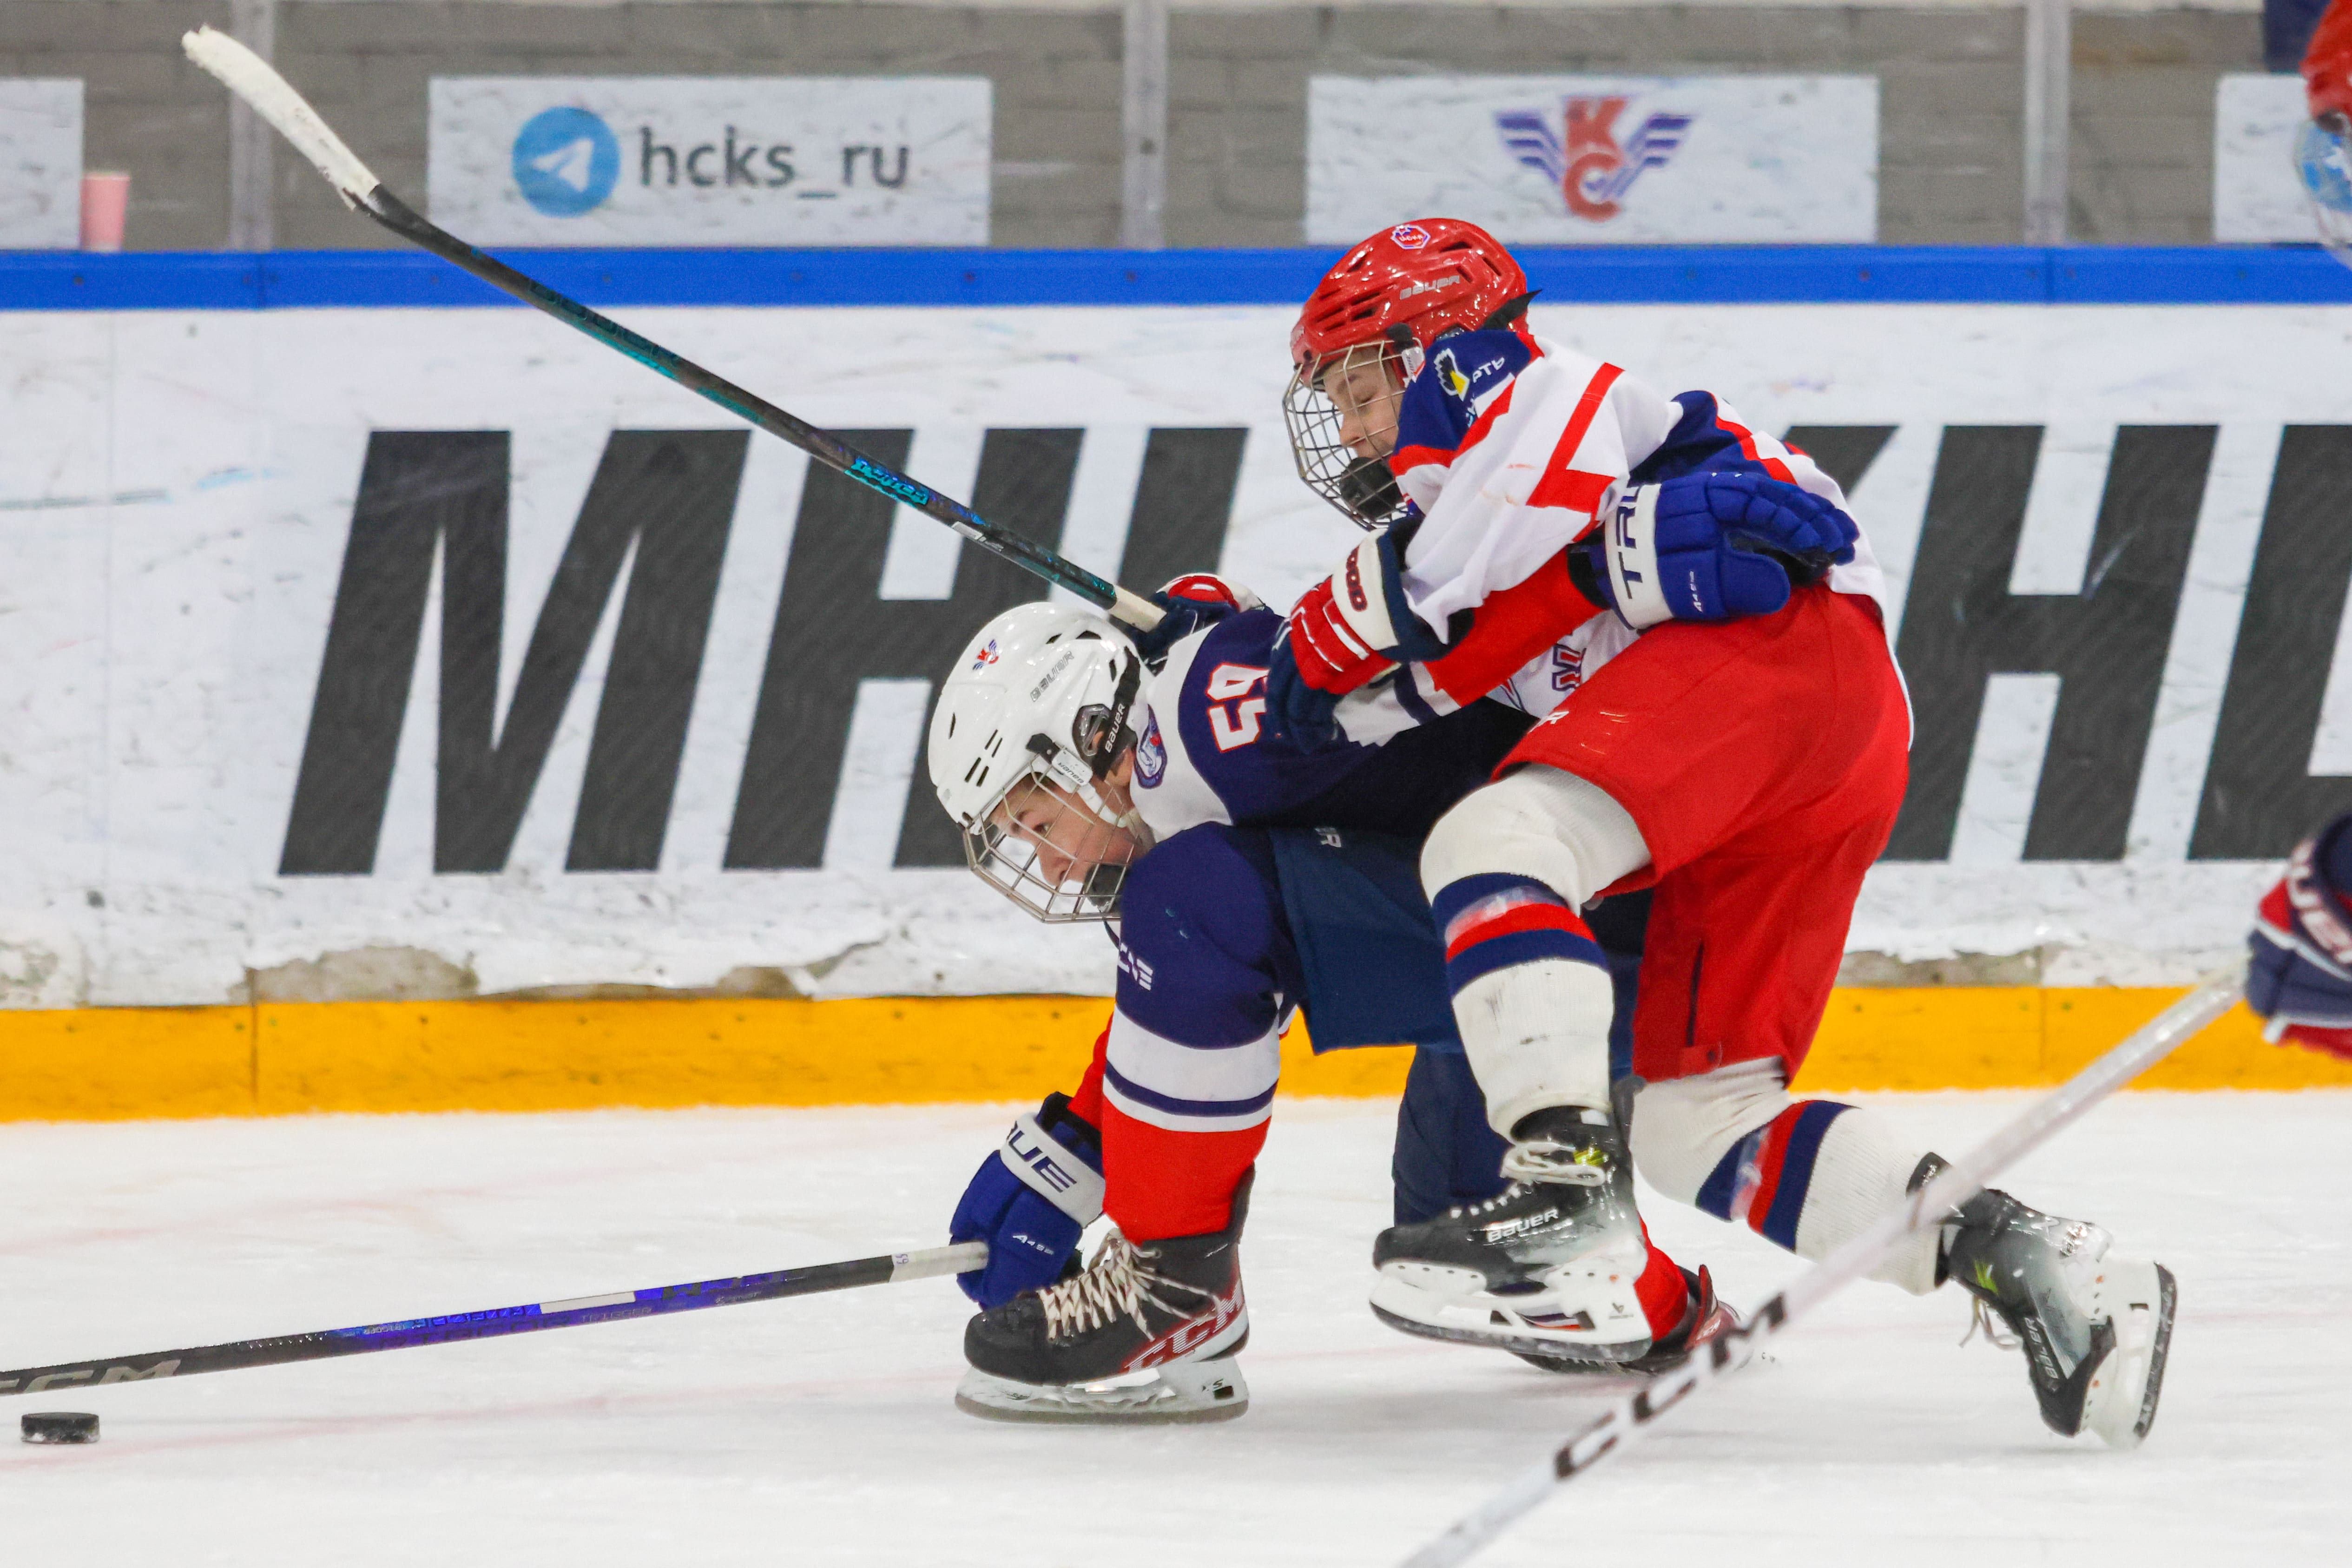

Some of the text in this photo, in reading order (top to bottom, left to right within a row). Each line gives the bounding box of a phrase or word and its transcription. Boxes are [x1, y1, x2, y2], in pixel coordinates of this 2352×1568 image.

[640, 125, 909, 198] hcks_ru
[1400, 275, 1461, 300] BAUER
[1780, 424, 2352, 863] HL
[1030, 651, 1074, 702] BAUER
[1105, 703, 1125, 753] BAUER
[1006, 1120, 1077, 1193] UE
[1487, 1208, 1559, 1244] BAUER
